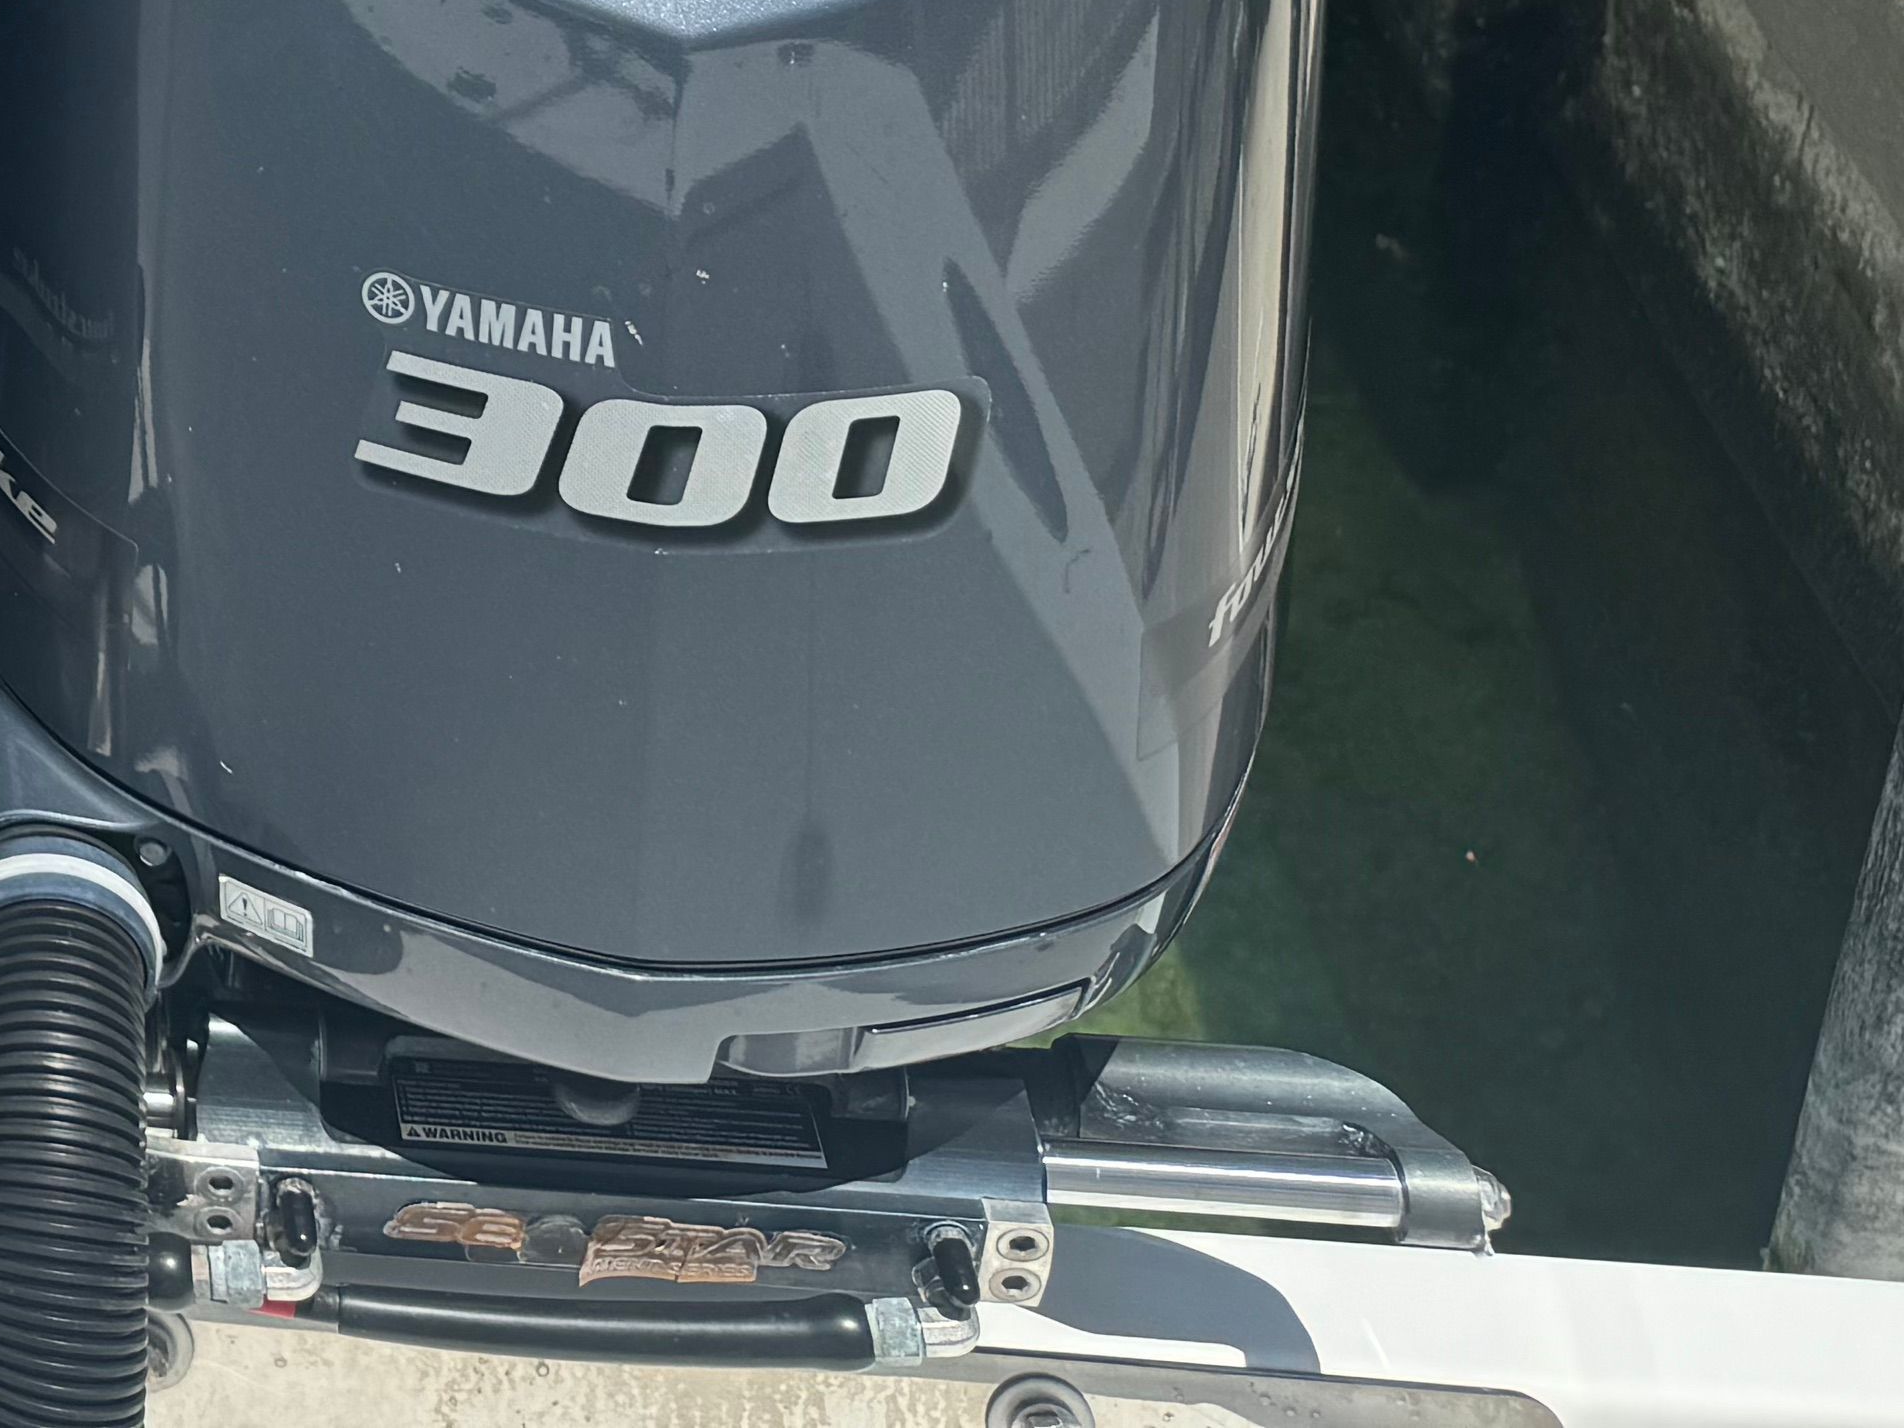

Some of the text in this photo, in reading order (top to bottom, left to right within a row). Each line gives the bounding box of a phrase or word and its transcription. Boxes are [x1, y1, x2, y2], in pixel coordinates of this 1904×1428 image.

[418, 283, 616, 369] YAMAHA
[354, 349, 962, 527] 300
[422, 1126, 508, 1145] WARNING
